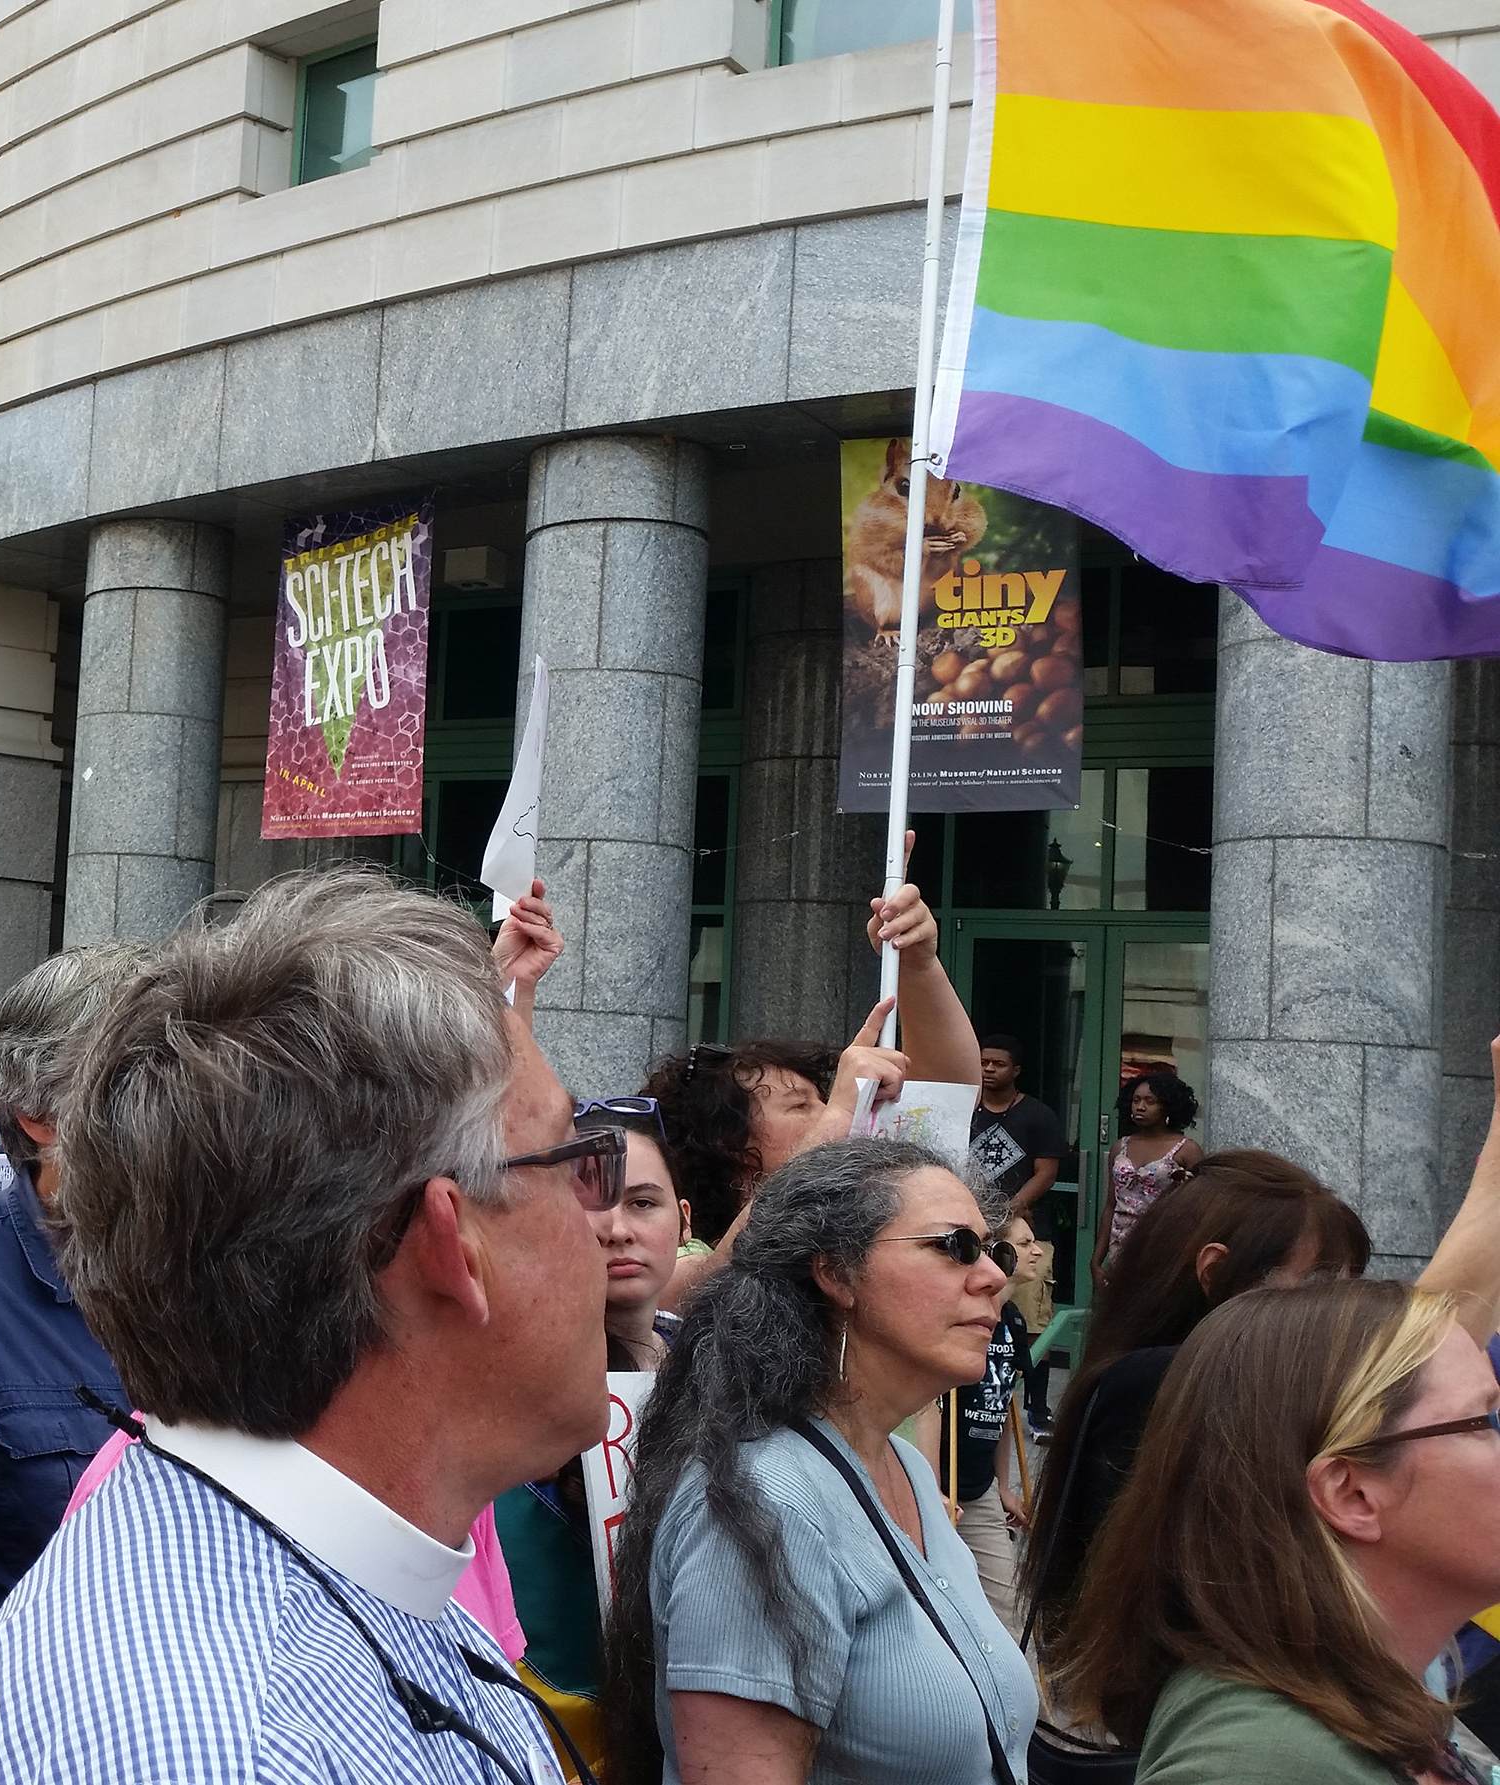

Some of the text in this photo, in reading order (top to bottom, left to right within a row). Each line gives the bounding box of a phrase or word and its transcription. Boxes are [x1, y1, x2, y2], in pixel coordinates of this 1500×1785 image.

[284, 512, 420, 571] TRIANGLE
[286, 532, 417, 648] SCI-TECH
[931, 559, 1067, 624] tiny
[937, 609, 1025, 629] GIANTS
[979, 627, 1016, 648] 3D
[304, 628, 390, 727] EXPO
[911, 700, 1013, 717] NOW SHOWING
[918, 718, 929, 728] THE
[930, 717, 960, 727] MUSEUM'S
[979, 716, 987, 725] 3D
[988, 715, 1013, 725] THEATER
[279, 767, 326, 798] IN APRIL
[940, 770, 976, 778] Museum
[978, 769, 986, 778] of
[987, 768, 1020, 777] Natural
[1021, 768, 1062, 776] Sciences
[321, 812, 350, 820] Museum
[357, 810, 382, 818] Natural
[382, 809, 415, 817] Sciences
[964, 1409, 979, 1421] WE
